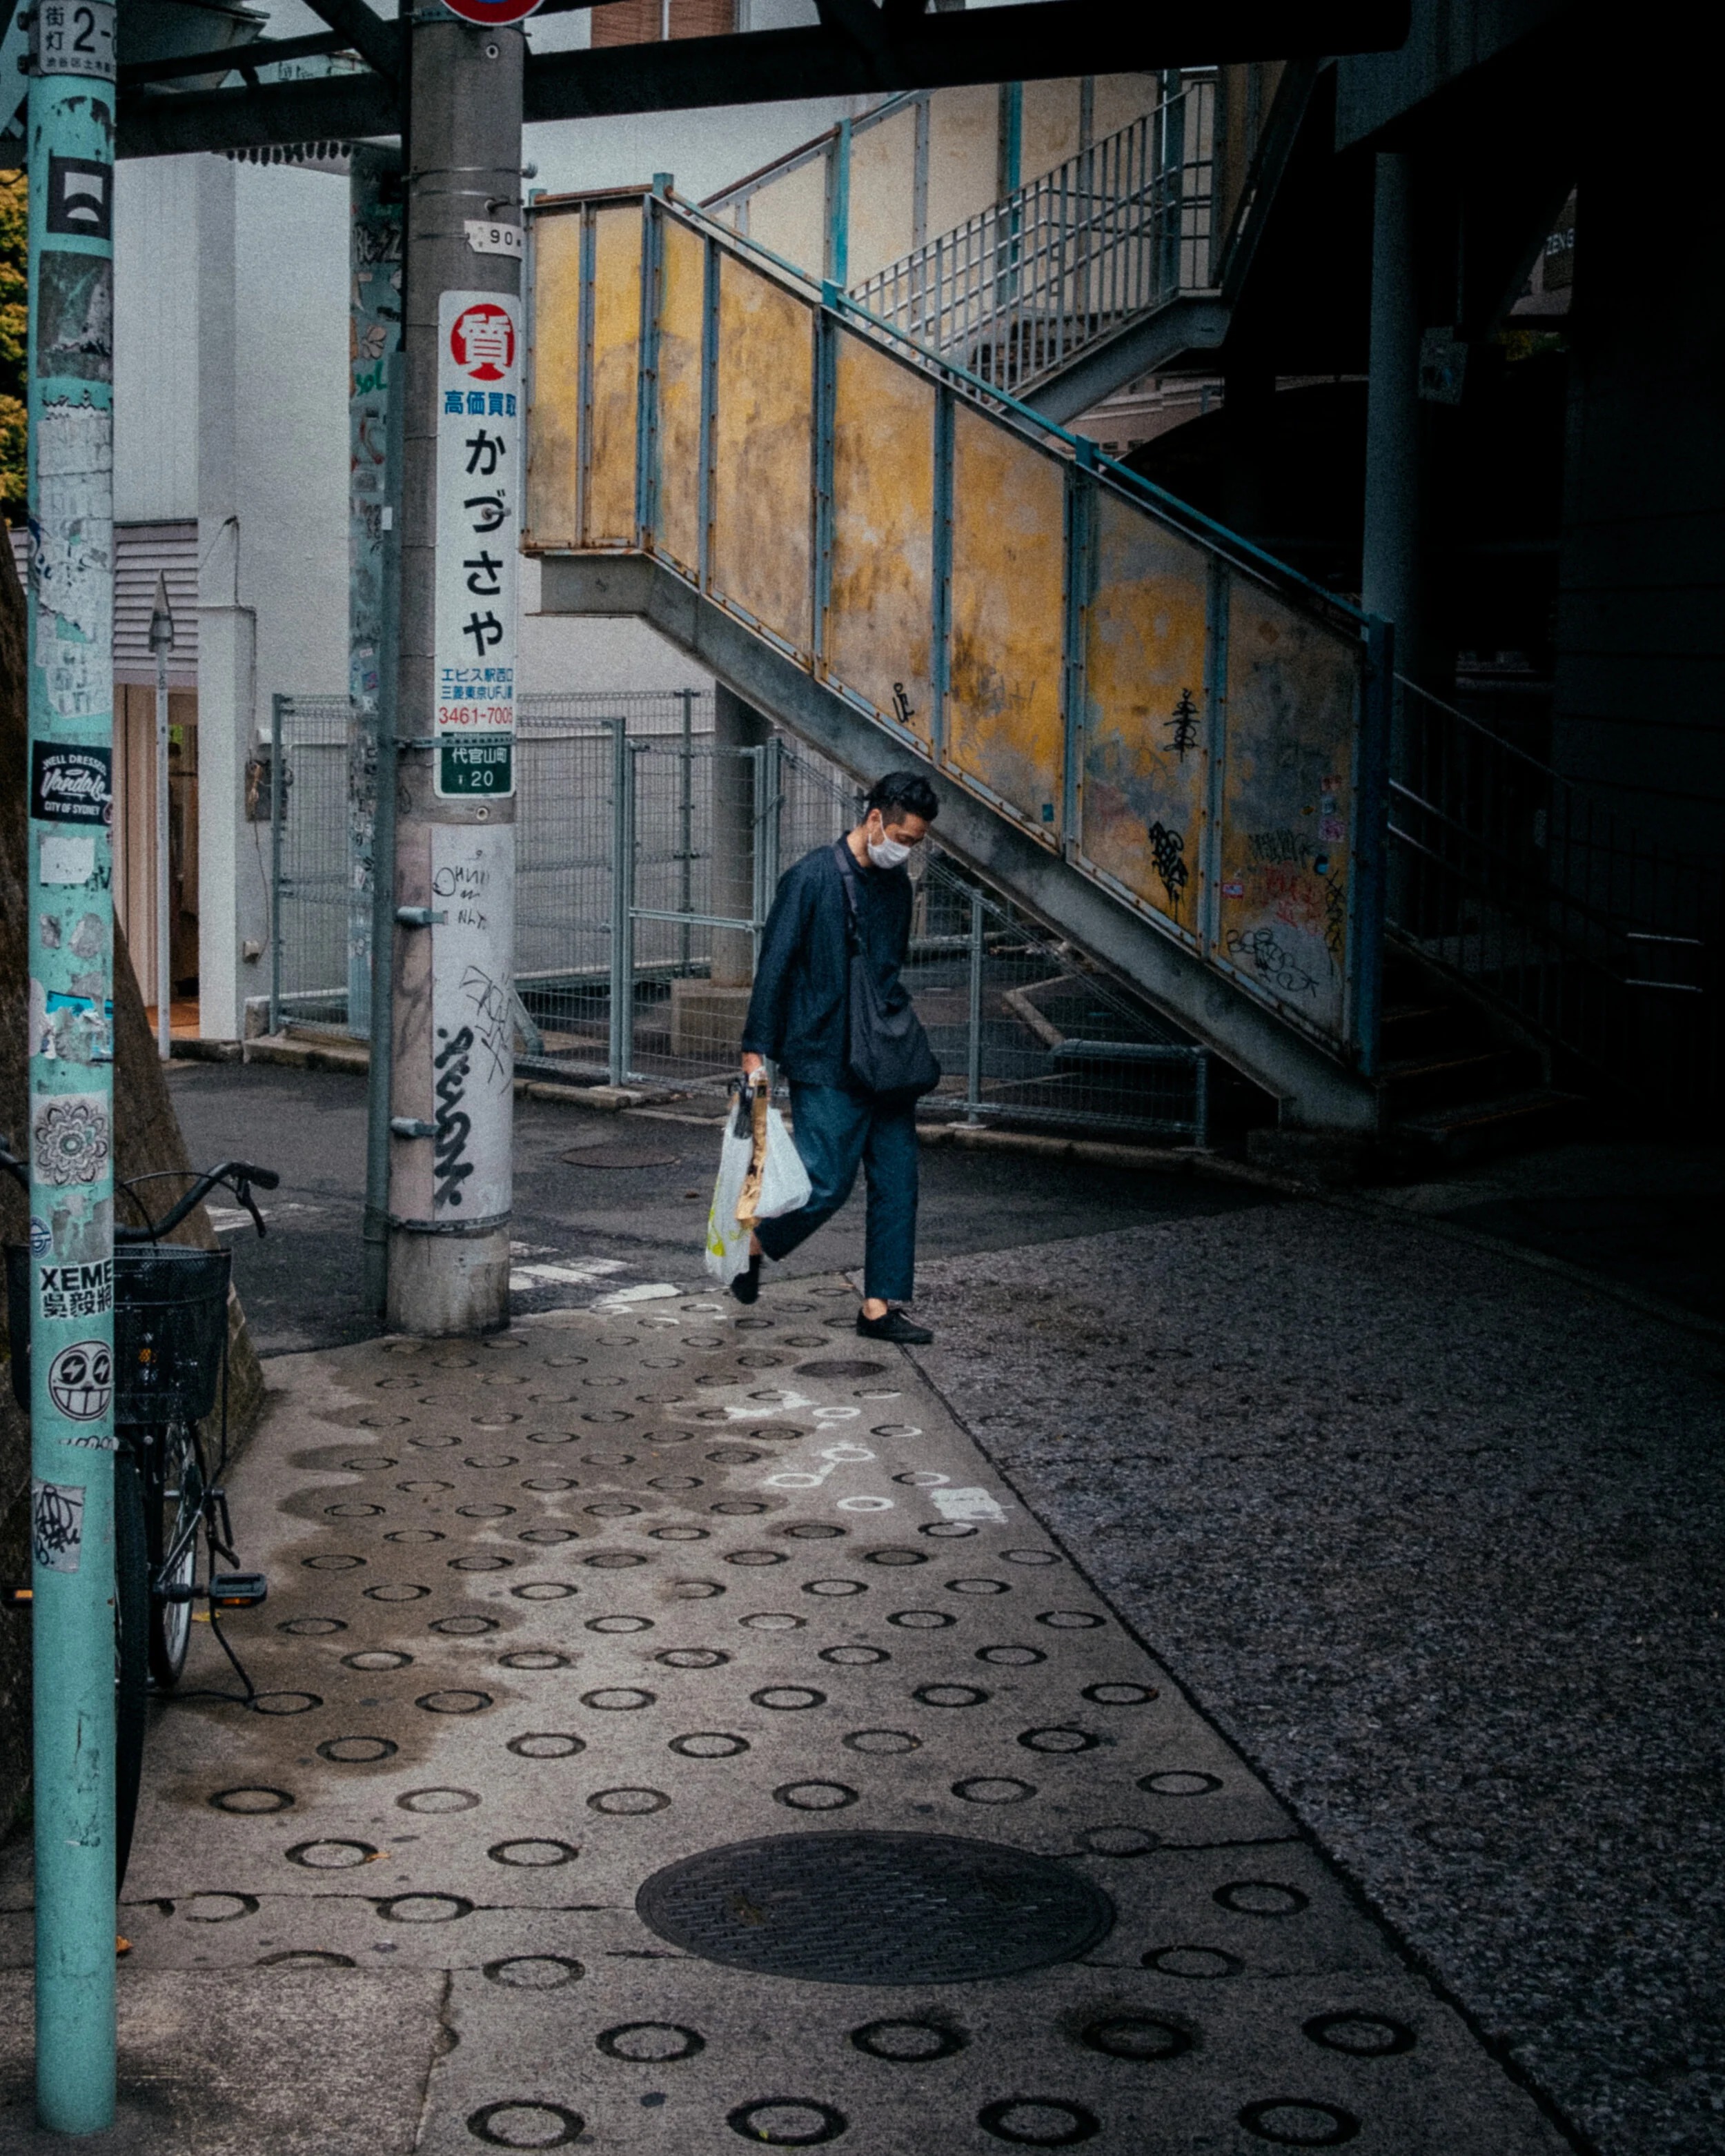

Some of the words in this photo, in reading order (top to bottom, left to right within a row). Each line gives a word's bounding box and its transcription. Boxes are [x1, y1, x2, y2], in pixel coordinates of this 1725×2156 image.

[46, 6, 65, 50] 街灯
[73, 6, 116, 55] 2-
[444, 389, 516, 417] 高価買取
[462, 428, 506, 657] かづさや
[42, 754, 68, 771] WELL
[451, 746, 507, 764] 代官山町
[471, 770, 494, 787] 20
[44, 800, 61, 813] CITY
[61, 802, 72, 814] OF
[72, 804, 101, 816] SYDNEY
[41, 1258, 112, 1292] XEME
